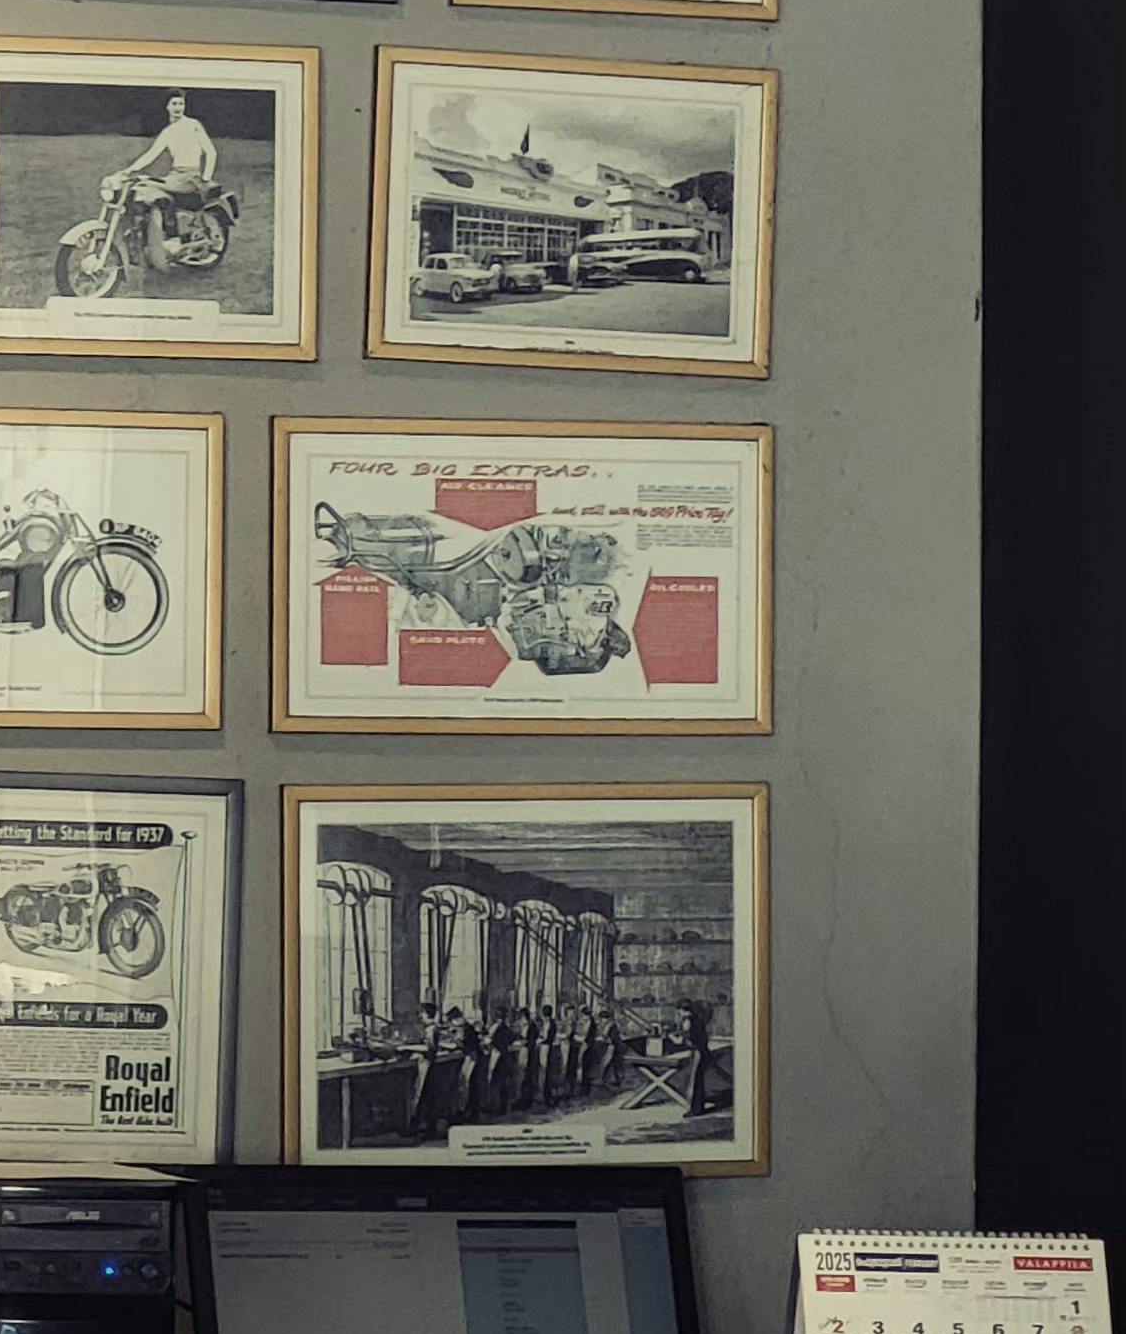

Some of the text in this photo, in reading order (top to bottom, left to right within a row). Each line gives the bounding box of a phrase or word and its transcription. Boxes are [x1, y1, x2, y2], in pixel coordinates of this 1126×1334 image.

[329, 462, 398, 475] FOUR
[411, 463, 457, 476] BIG
[37, 825, 56, 840] the
[60, 824, 113, 842] Standard
[116, 826, 132, 842] for
[136, 826, 165, 843] 1937
[132, 1007, 158, 1024] Year
[105, 1055, 171, 1087] Royal
[100, 1085, 174, 1113] Enfield
[815, 1252, 851, 1271] 2025
[1071, 1300, 1080, 1314] 1
[832, 1319, 844, 1334] 2
[872, 1321, 884, 1334] 3
[913, 1322, 925, 1334] 4
